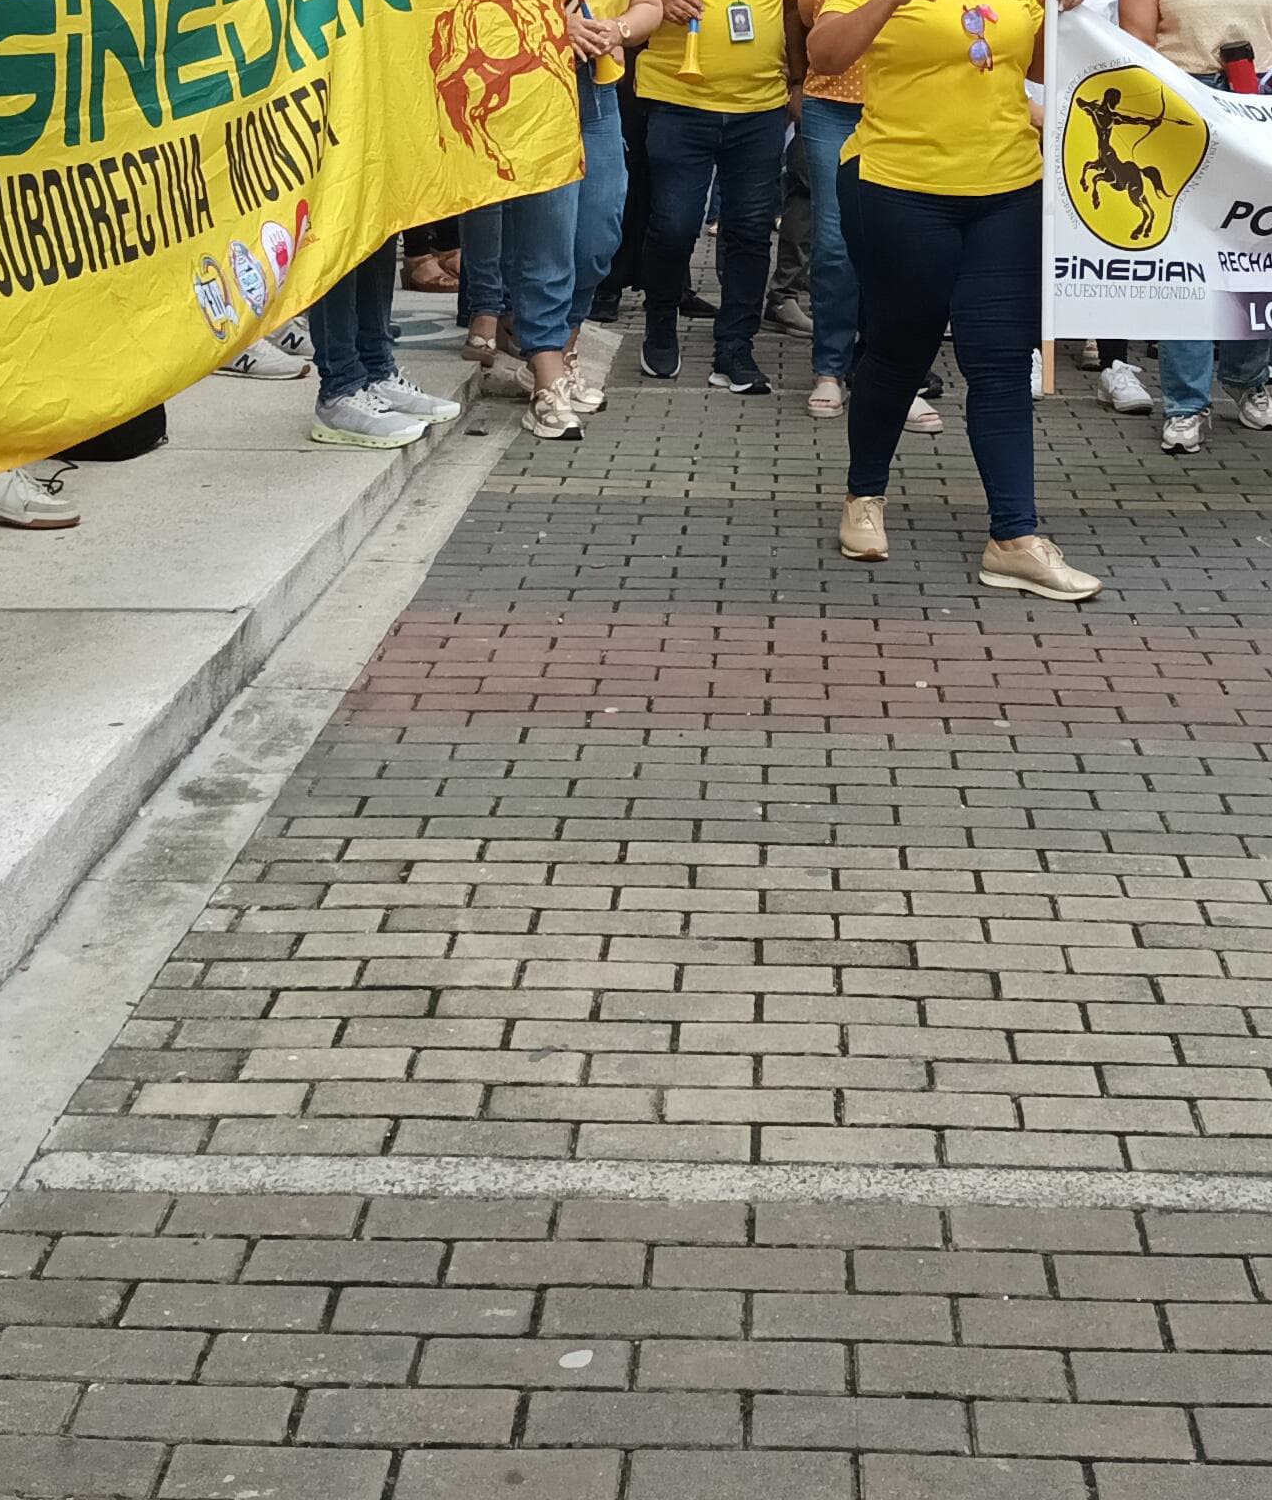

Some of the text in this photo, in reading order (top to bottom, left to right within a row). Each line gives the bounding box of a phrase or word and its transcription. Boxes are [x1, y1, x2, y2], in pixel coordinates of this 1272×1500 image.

[1064, 282, 1127, 300] CUESTIÓN
[1129, 284, 1147, 300] DE
[1148, 284, 1206, 301] DIGNIDAD
